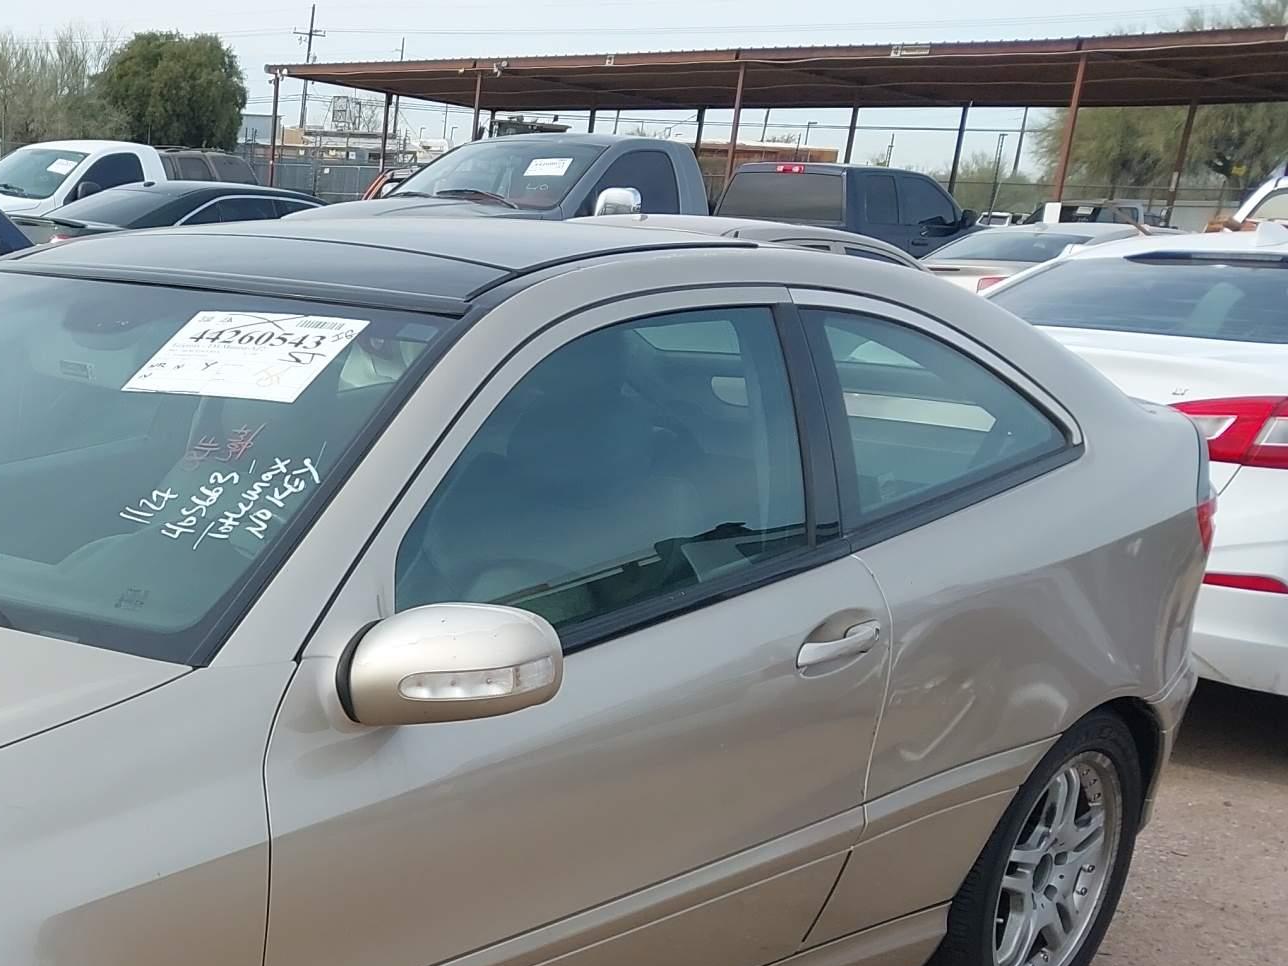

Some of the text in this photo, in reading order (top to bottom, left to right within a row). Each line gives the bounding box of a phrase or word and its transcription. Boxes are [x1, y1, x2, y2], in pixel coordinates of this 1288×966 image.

[189, 328, 326, 349] 44260543
[244, 458, 320, 540] NO KEY
